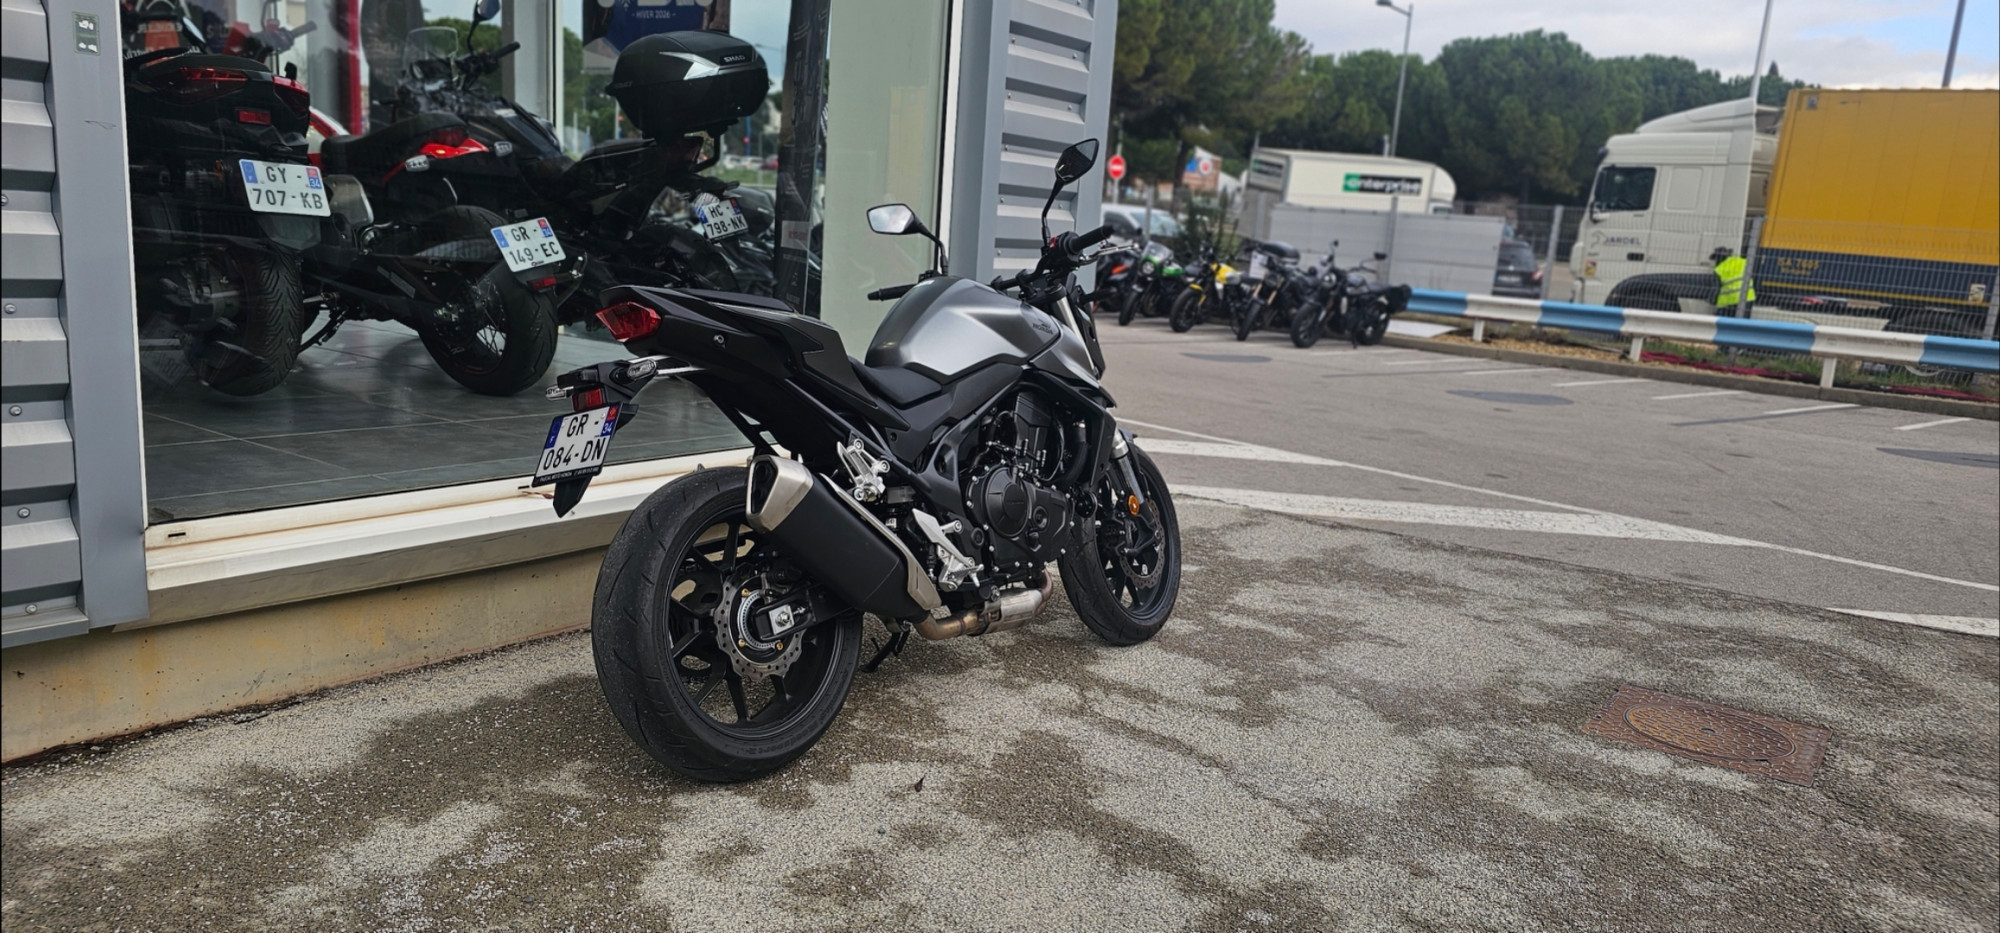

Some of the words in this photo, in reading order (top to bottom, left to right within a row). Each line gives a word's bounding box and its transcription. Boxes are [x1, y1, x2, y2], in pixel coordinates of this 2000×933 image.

[636, 10, 653, 18] HIVER
[723, 55, 746, 63] SHAD
[602, 422, 612, 433] 34
[543, 437, 606, 470] 084-DN
